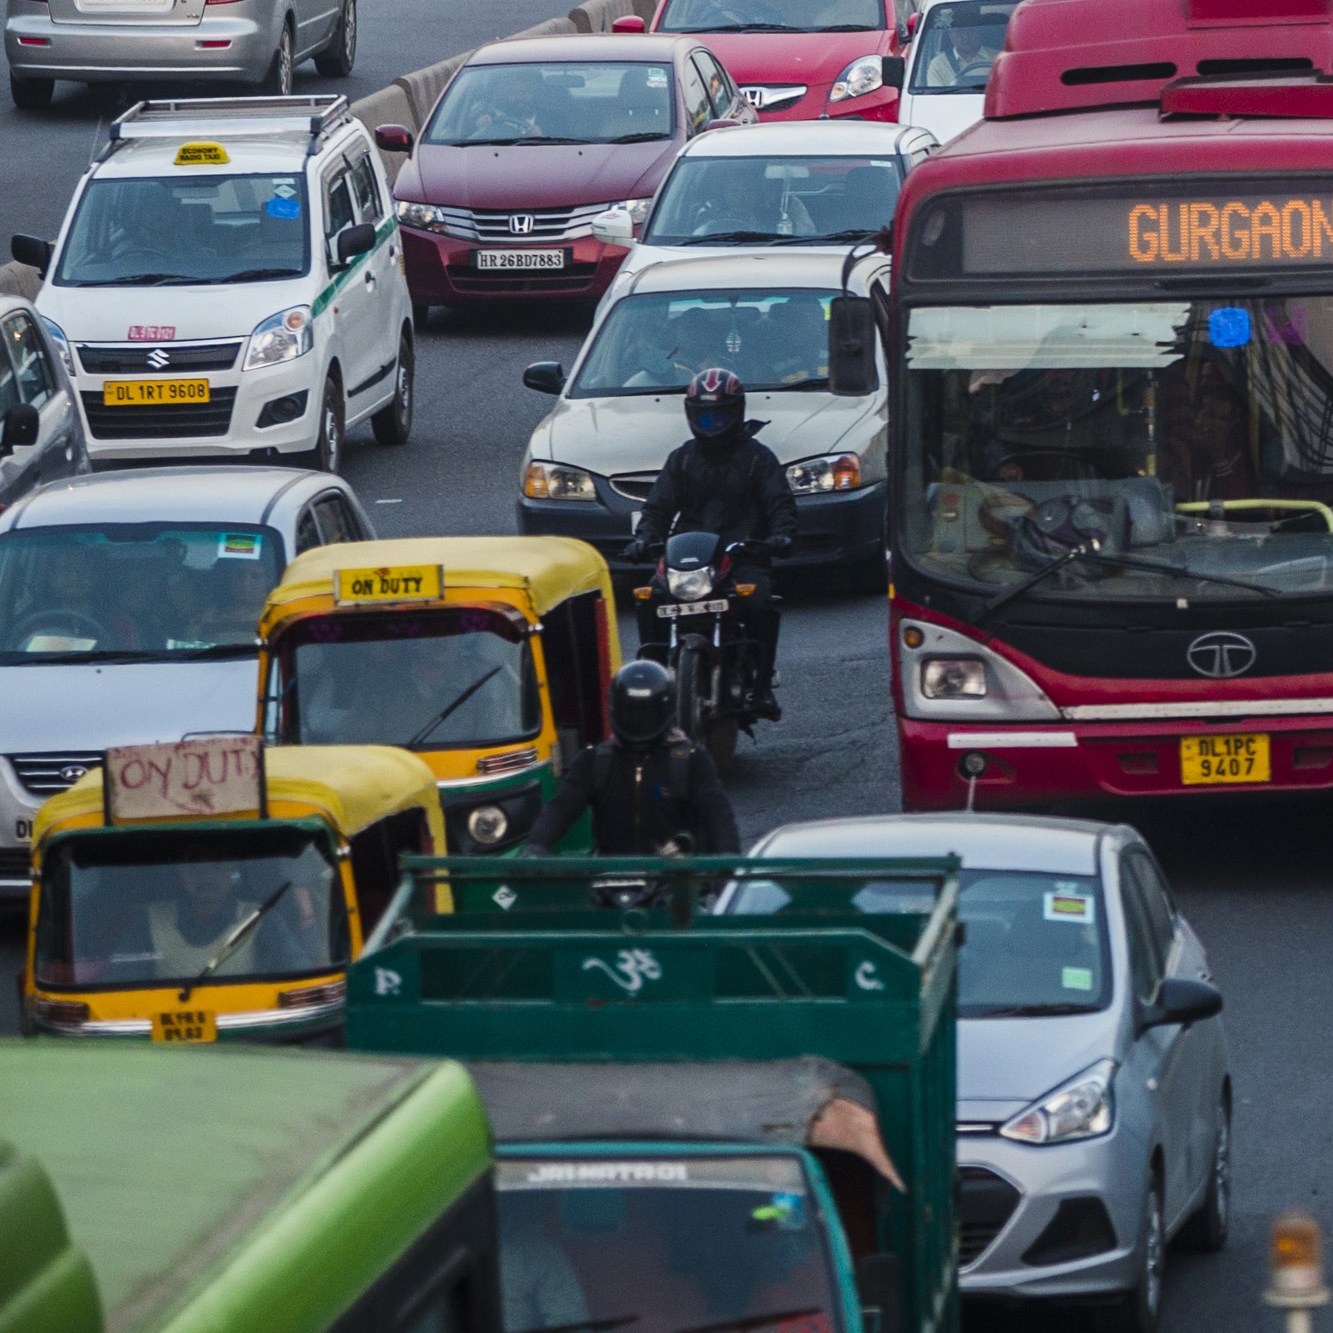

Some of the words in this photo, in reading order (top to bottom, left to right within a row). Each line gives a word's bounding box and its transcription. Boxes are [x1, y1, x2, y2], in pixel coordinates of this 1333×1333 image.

[202, 153, 221, 161] TAXI
[480, 254, 498, 267] HR
[500, 254, 562, 267] 26BD7883
[116, 386, 135, 401] DL
[138, 385, 165, 400] 1RT
[169, 382, 206, 399] 9608
[351, 579, 374, 595] ON
[379, 576, 424, 595] DUTY
[1201, 758, 1256, 777] 9407
